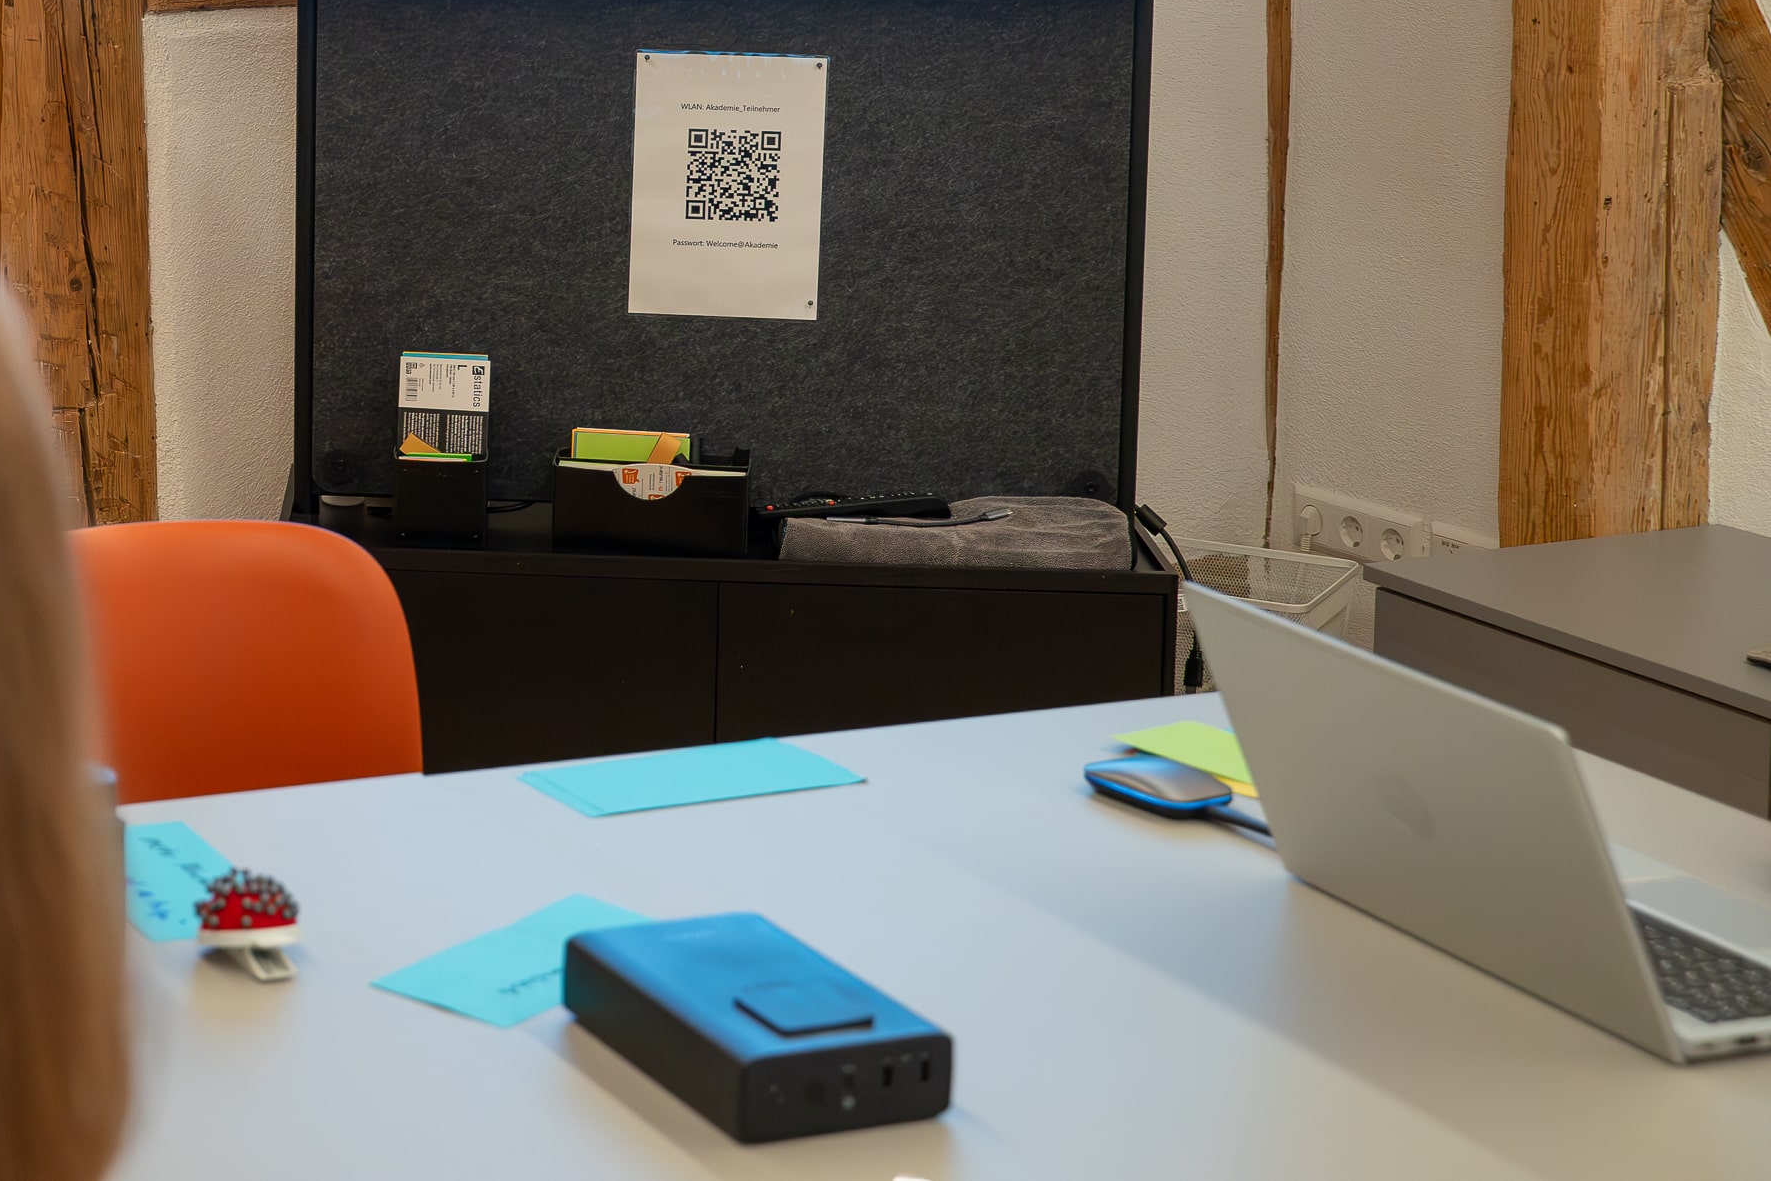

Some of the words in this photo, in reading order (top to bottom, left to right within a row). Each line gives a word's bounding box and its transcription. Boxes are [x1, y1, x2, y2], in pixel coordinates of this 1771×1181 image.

[680, 102, 704, 111] WLAN:
[705, 103, 781, 113] Akademie_Teilnehmer
[672, 239, 705, 248] Passwort:
[705, 239, 779, 249] Welcome@Akademie
